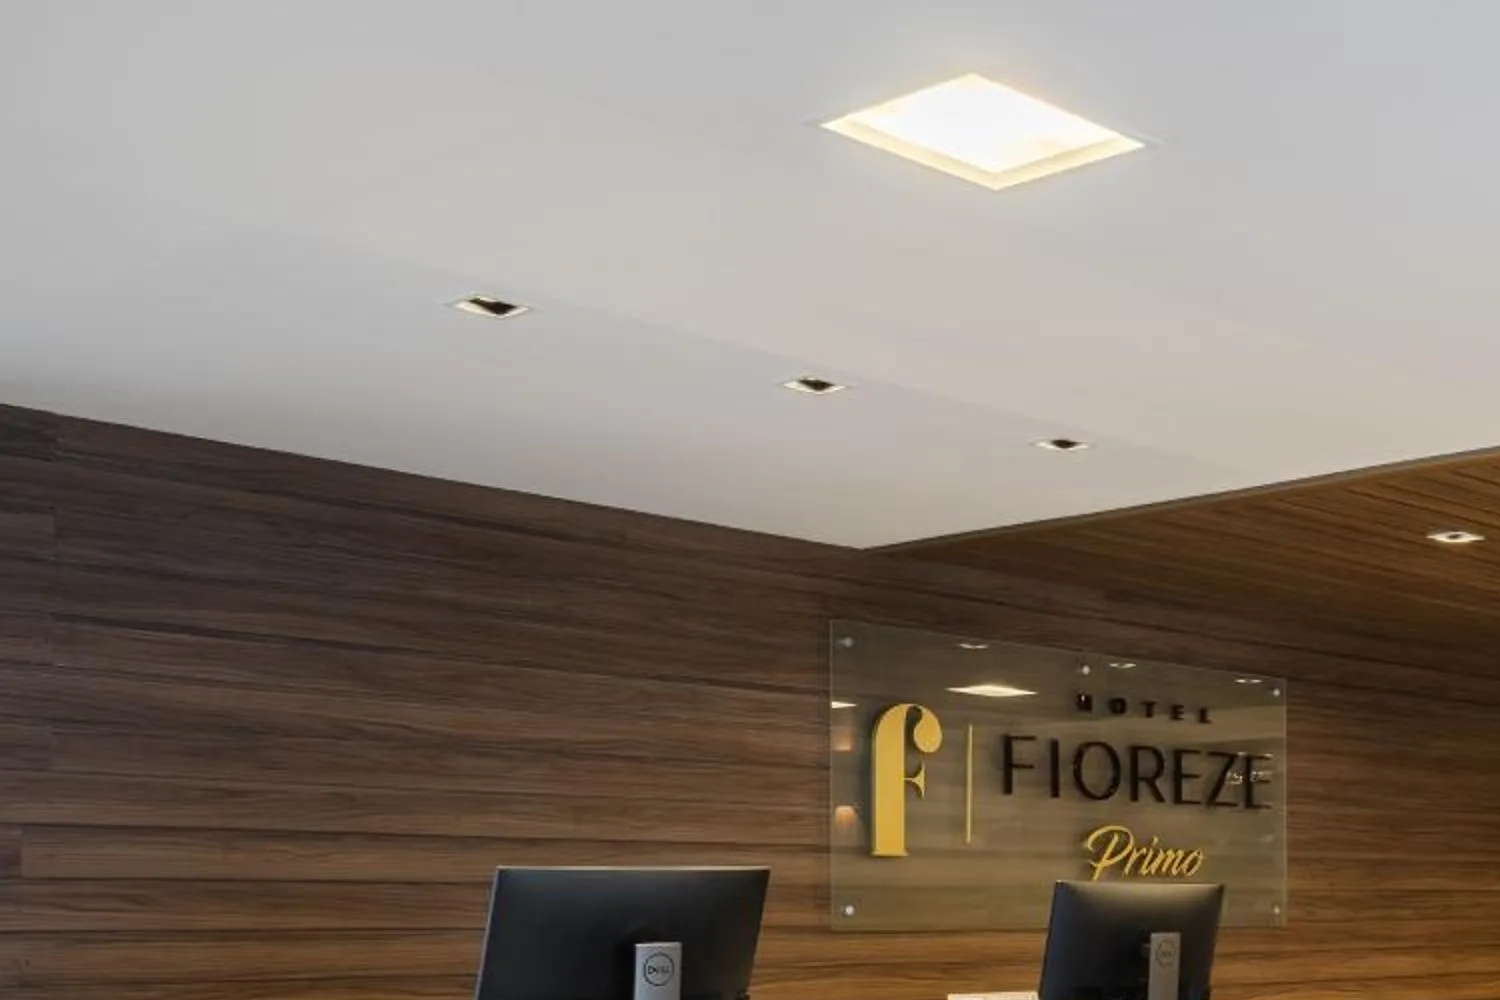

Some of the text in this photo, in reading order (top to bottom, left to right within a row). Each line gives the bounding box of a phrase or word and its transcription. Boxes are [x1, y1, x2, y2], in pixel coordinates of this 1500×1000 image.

[1075, 693, 1212, 724] HOTEL
[1003, 734, 1272, 810] FIOREZE
[1085, 825, 1207, 881] Primo
